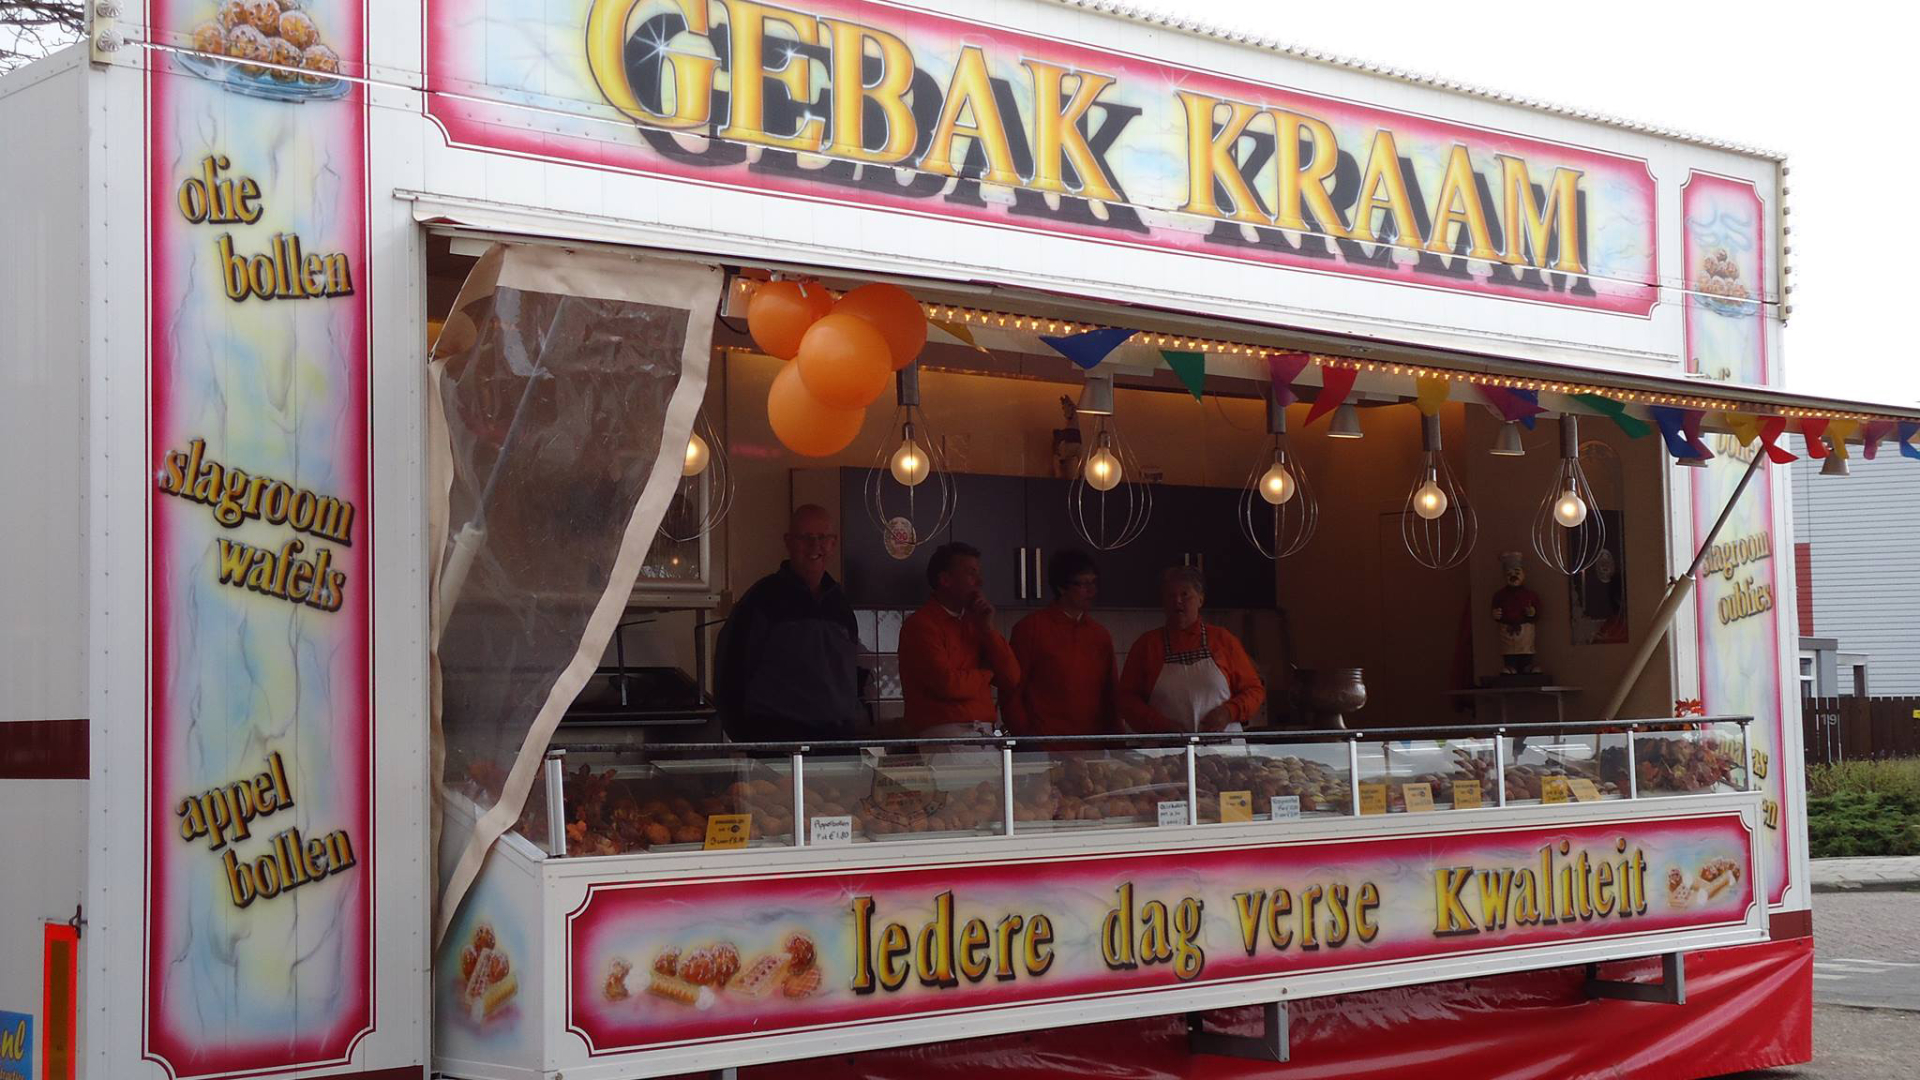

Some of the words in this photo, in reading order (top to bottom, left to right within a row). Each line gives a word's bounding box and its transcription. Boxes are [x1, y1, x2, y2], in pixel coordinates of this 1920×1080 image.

[585, 0, 1134, 212] GEBAK
[1174, 90, 1592, 284] KRAAM
[178, 156, 263, 224] olie
[217, 233, 354, 302] bollen
[157, 437, 355, 548] slagroom
[216, 538, 347, 613] wafels
[1719, 576, 1773, 626] oublies
[1820, 713, 1837, 726] 19
[178, 751, 293, 850] appel
[221, 827, 357, 909] bollen
[849, 889, 1056, 995] Iedere
[1100, 881, 1205, 981] dag
[1233, 880, 1381, 957] verse
[1431, 836, 1648, 938] Kwaliteit
[0, 1019, 26, 1062] nl
